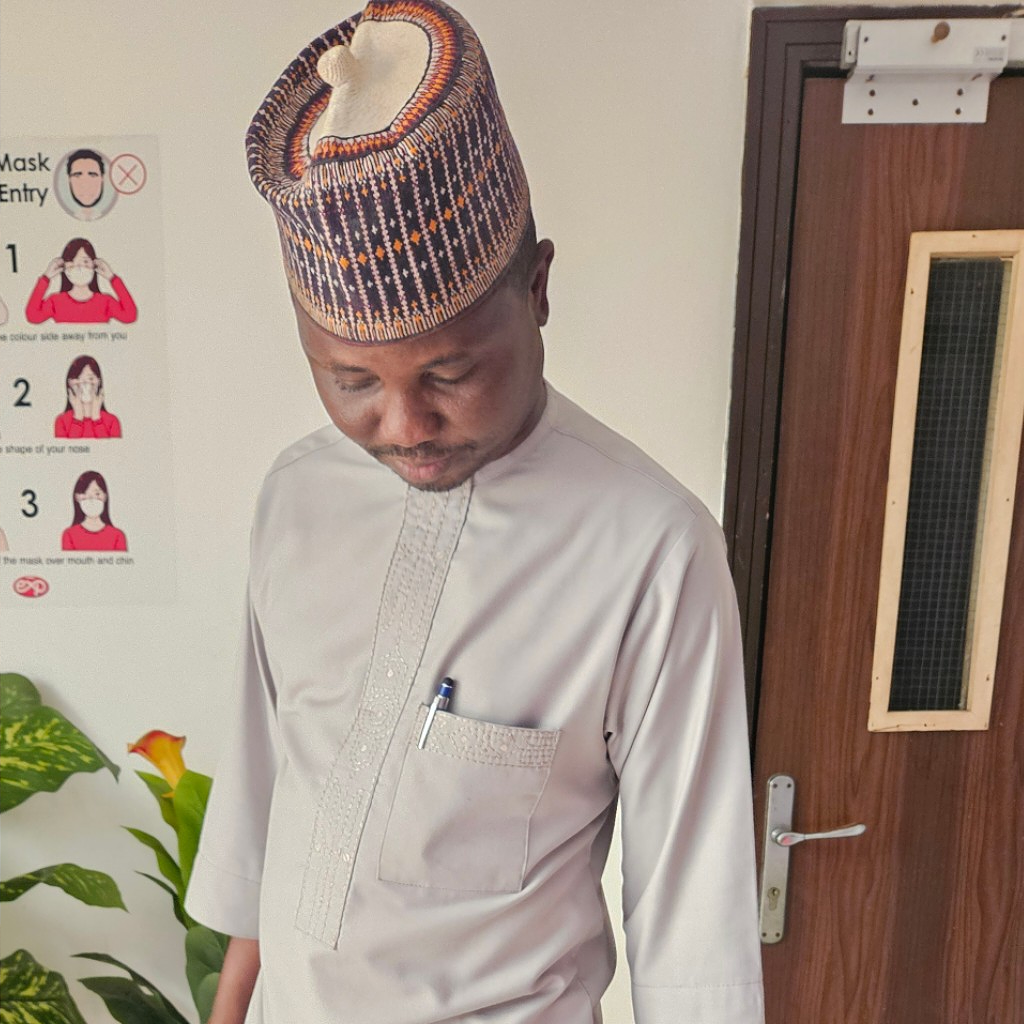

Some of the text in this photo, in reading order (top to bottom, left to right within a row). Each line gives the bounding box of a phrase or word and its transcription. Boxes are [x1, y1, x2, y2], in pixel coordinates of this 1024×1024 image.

[0, 152, 50, 172] Mask
[0, 184, 49, 207] Entry
[6, 244, 18, 273] 1
[62, 333, 85, 342] away
[87, 331, 109, 340] from
[13, 378, 32, 407] 2
[5, 444, 33, 455] shape
[46, 445, 66, 456] your
[68, 445, 91, 454] nose
[21, 489, 39, 518] 3
[20, 556, 43, 565] mask
[67, 556, 95, 565] mouth
[97, 556, 114, 565] and
